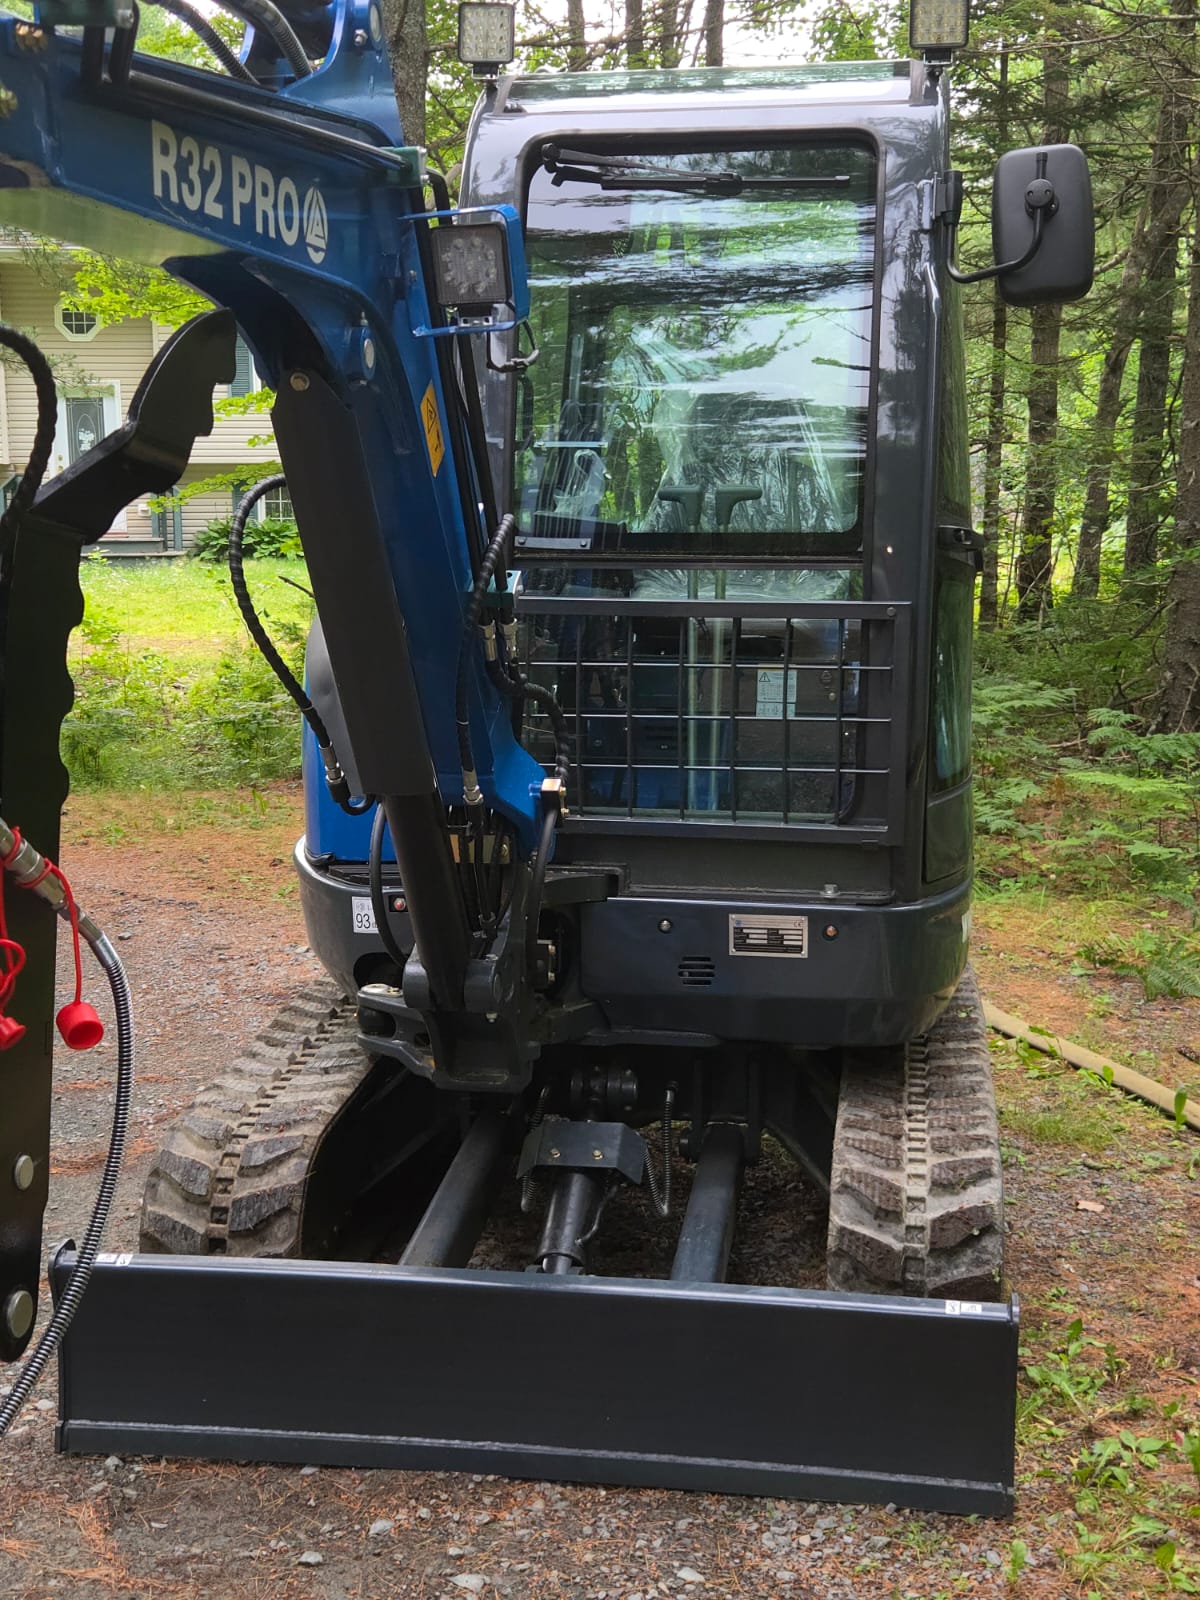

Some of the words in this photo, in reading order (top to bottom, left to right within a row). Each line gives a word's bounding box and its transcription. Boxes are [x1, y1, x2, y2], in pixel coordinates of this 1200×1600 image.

[152, 119, 223, 219] R32
[231, 155, 300, 246] PRO
[356, 913, 370, 929] 93
